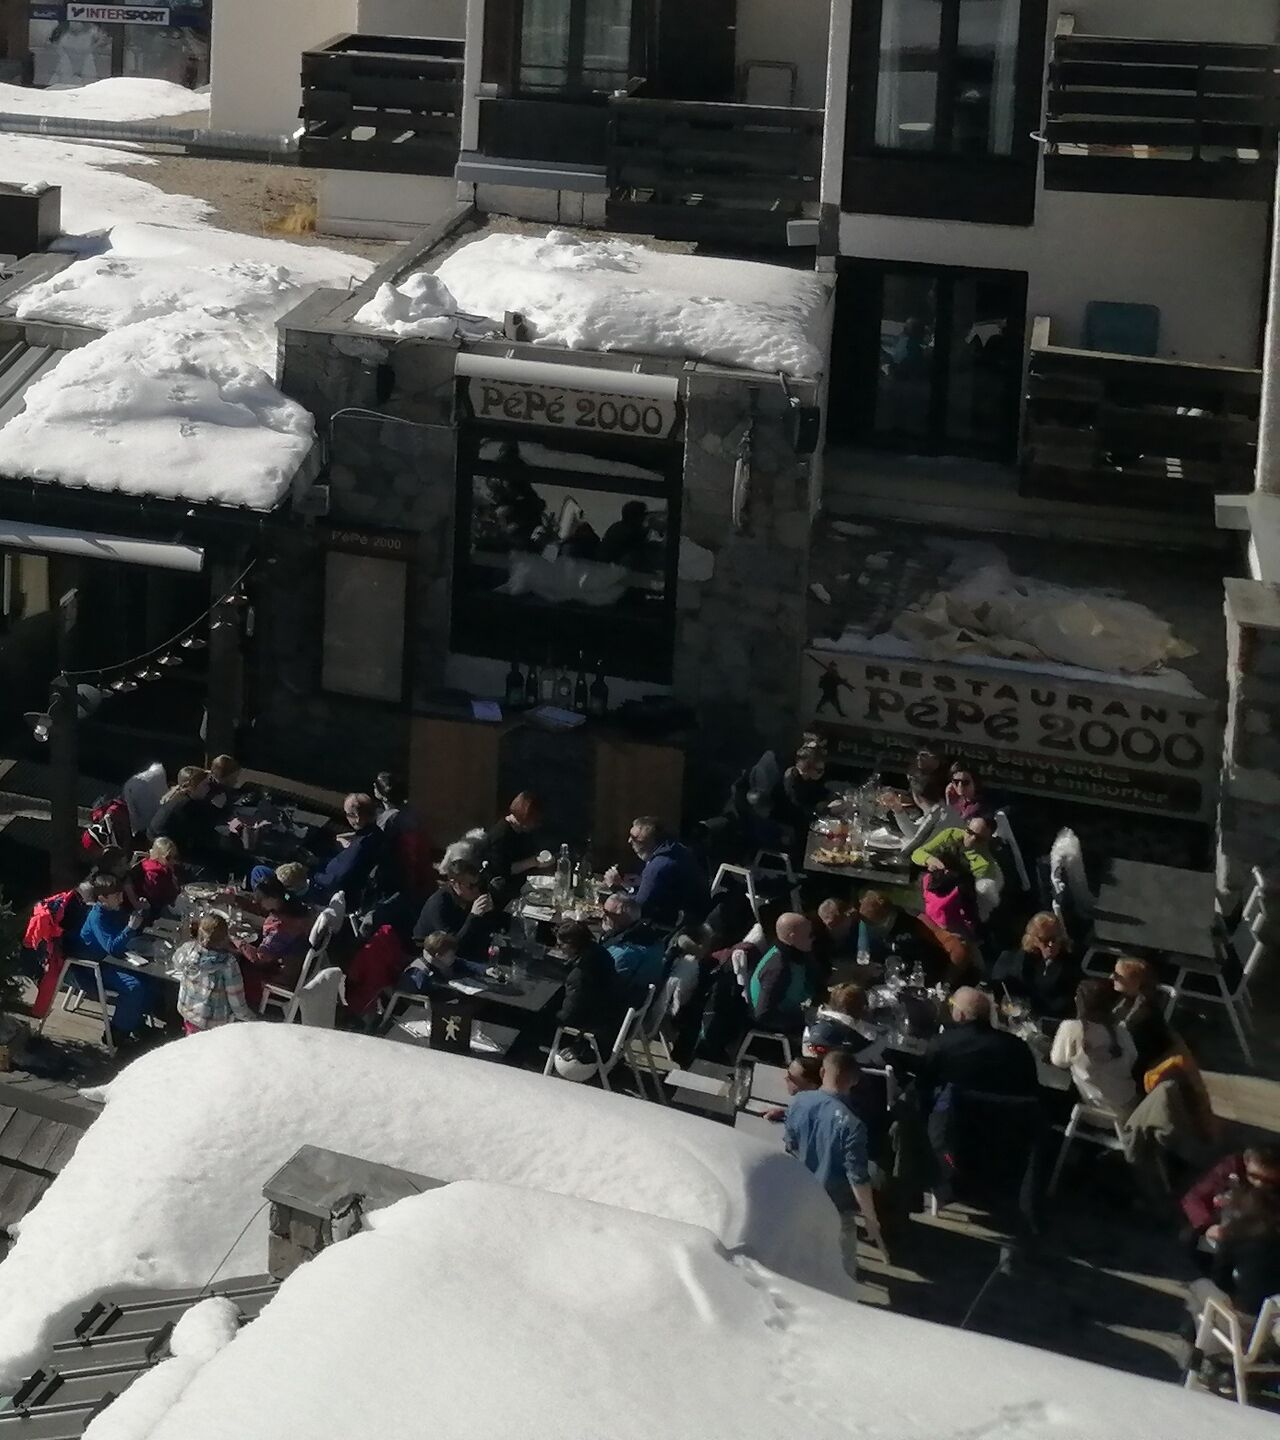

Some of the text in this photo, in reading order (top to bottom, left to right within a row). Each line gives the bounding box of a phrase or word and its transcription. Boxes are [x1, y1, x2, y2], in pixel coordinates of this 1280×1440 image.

[86, 7, 166, 23] INTERSPORT
[575, 397, 663, 436] 2000
[373, 536, 402, 550] 2000
[864, 665, 1208, 729] RESTAURANT
[1038, 712, 1205, 770] 2000
